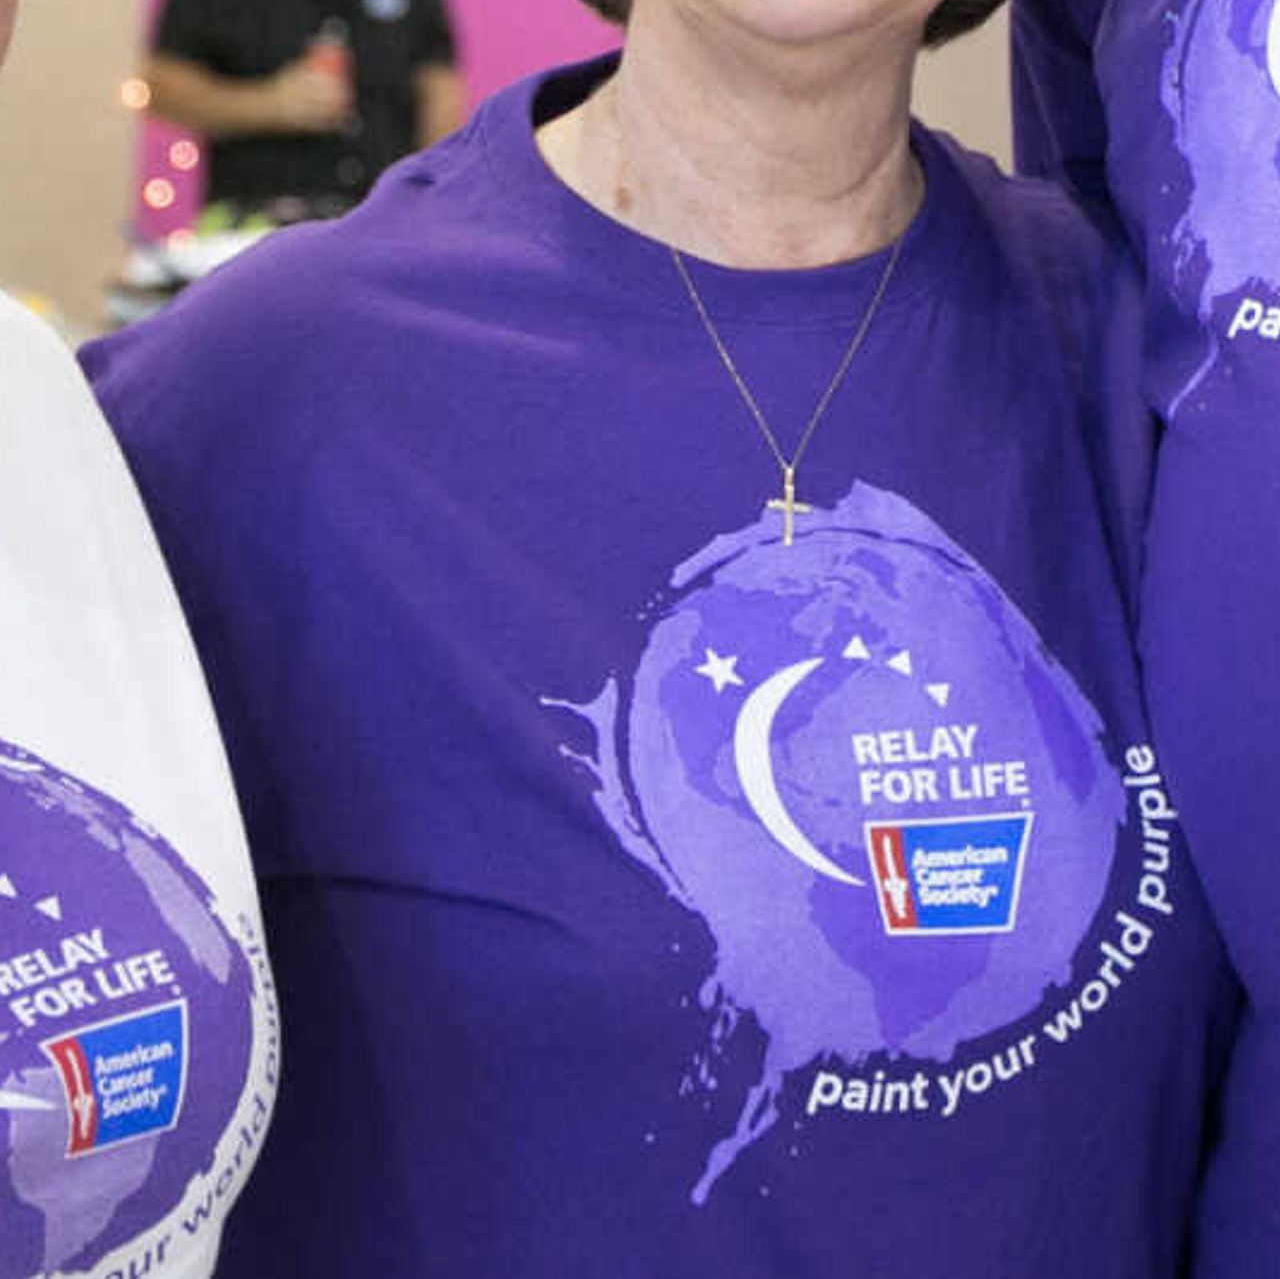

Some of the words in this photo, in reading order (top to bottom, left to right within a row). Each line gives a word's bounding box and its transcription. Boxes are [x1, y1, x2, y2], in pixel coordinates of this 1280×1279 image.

[851, 724, 978, 765] RELAY
[859, 768, 940, 805] FOR
[948, 761, 1030, 800] LIFE
[912, 844, 1009, 869] American
[914, 867, 984, 886] Cancer
[805, 1071, 929, 1115] paint
[937, 1034, 1037, 1116] your
[1043, 910, 1155, 1044] world
[1123, 744, 1178, 915] purple
[8, 976, 98, 1028] FOR
[93, 950, 176, 999] LIFE
[95, 1041, 174, 1077] American
[97, 1067, 155, 1096] Cancer
[183, 1094, 268, 1235] world
